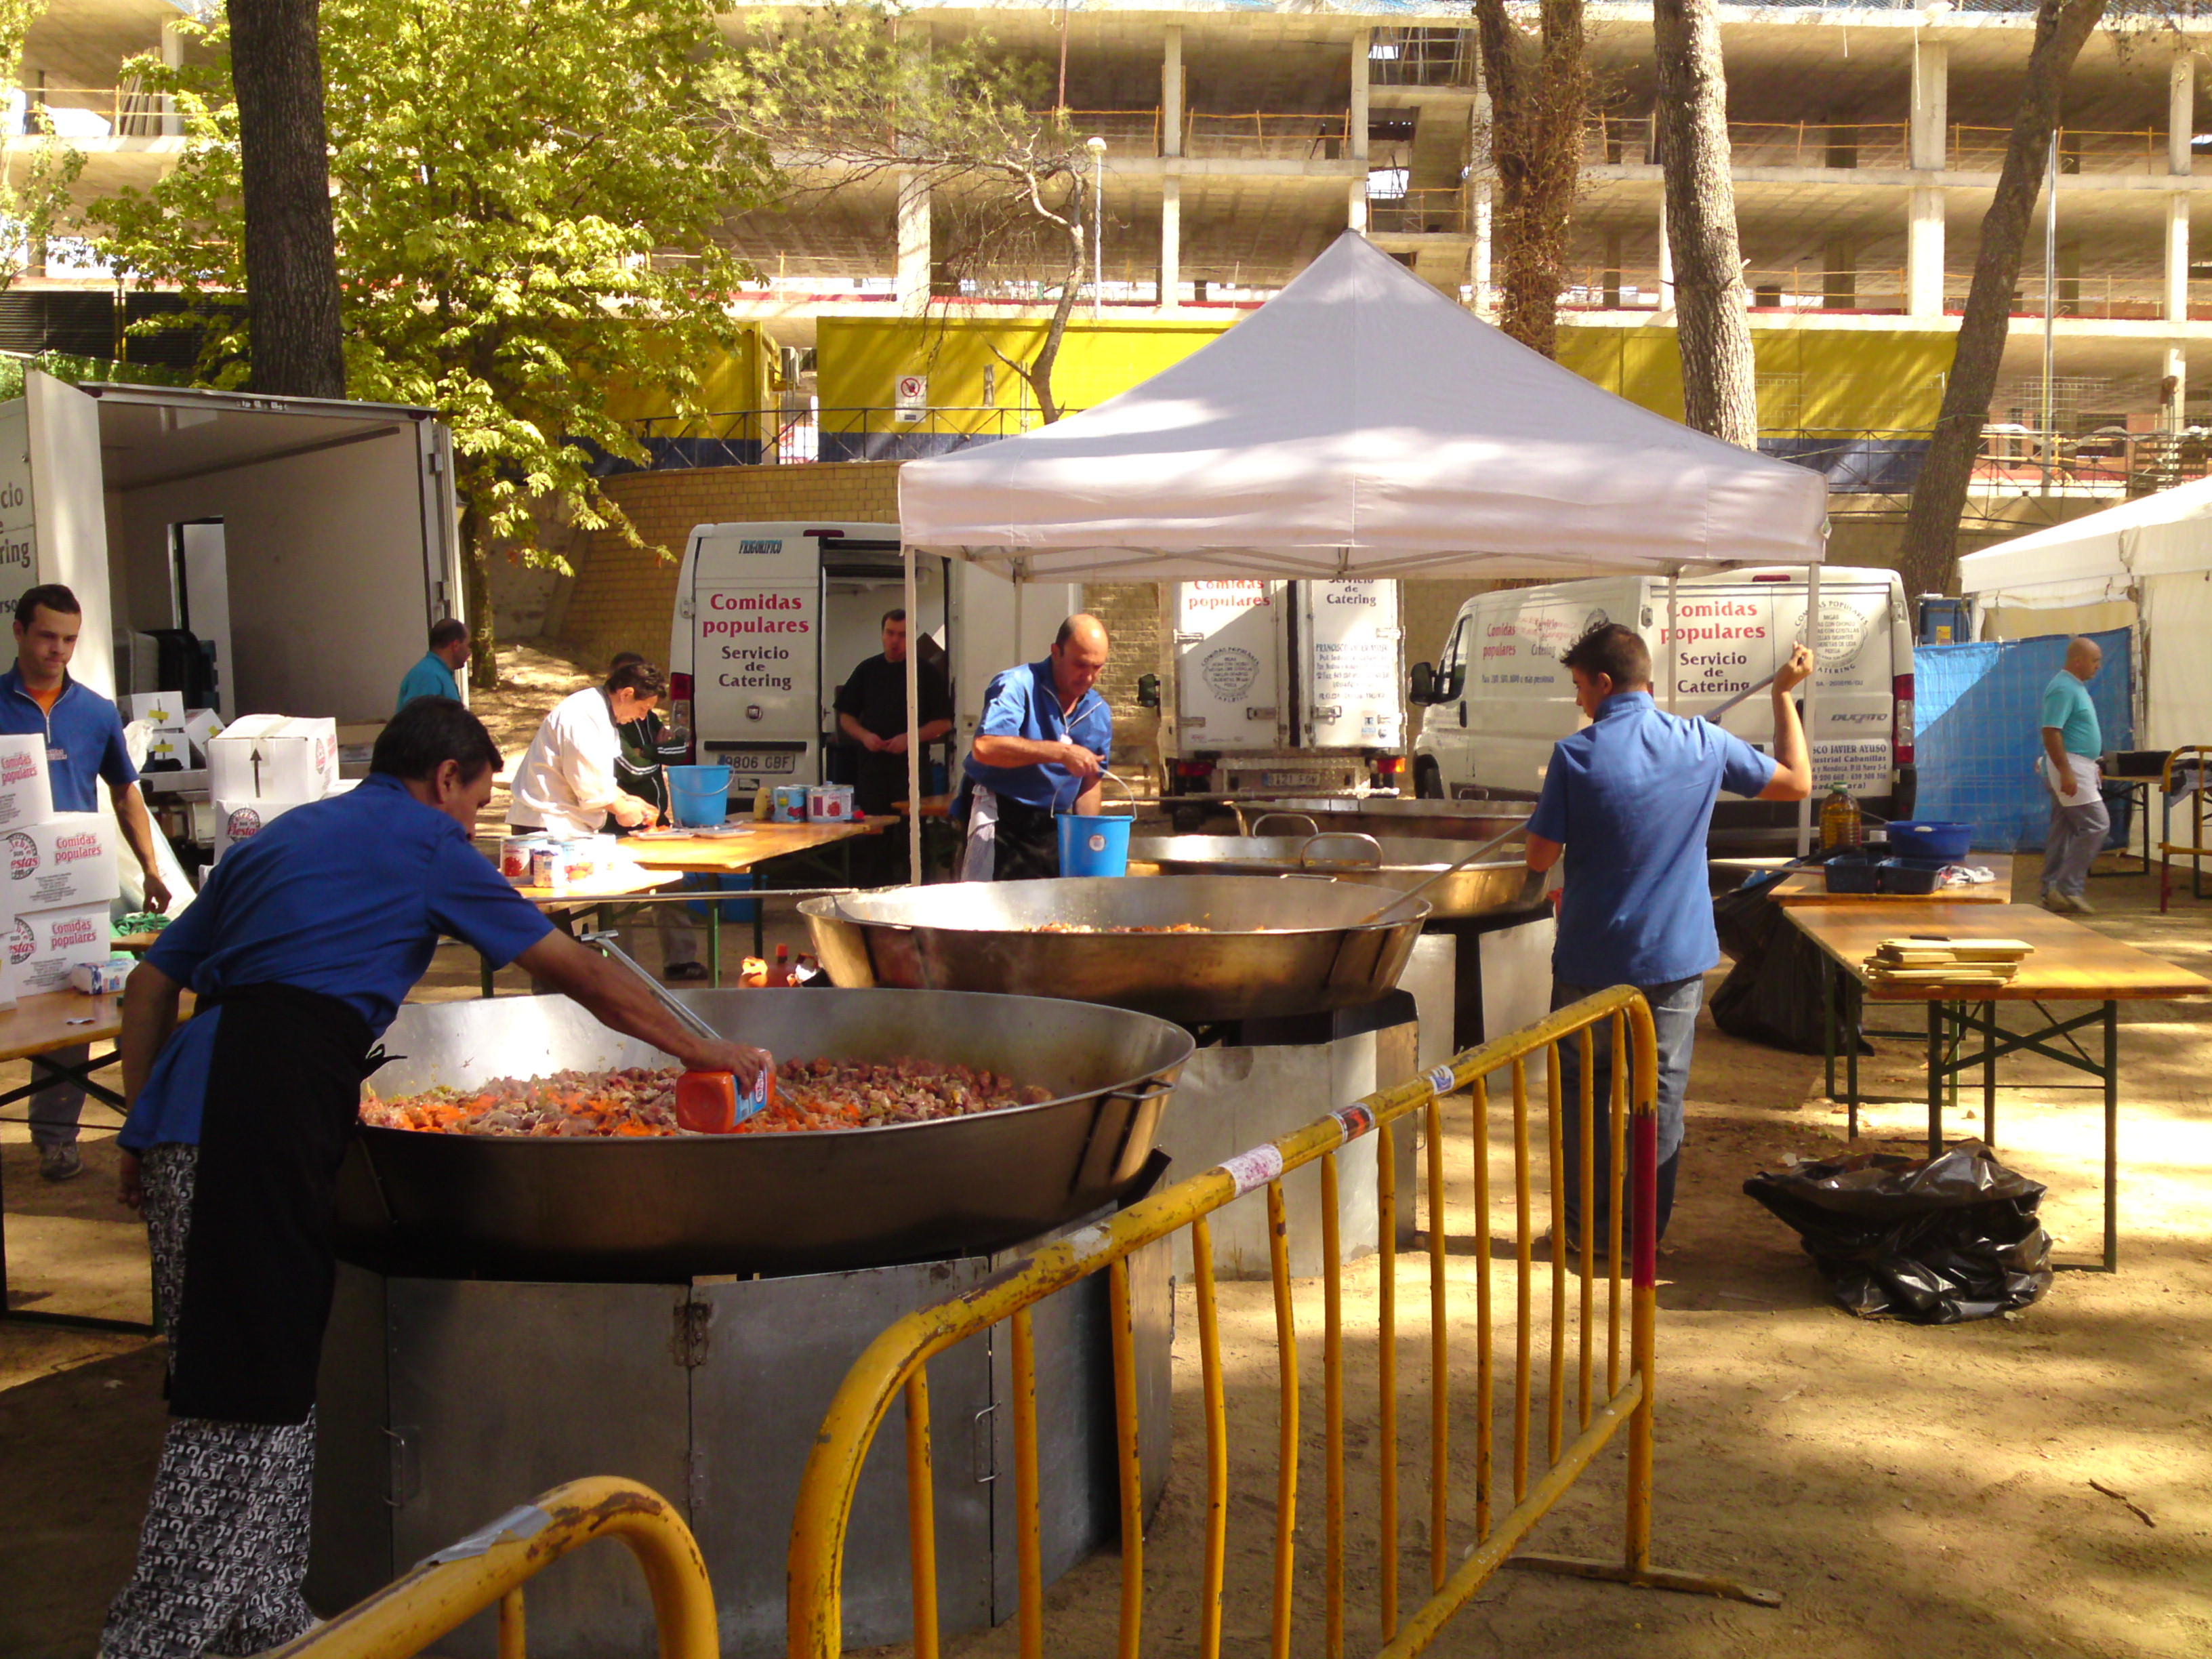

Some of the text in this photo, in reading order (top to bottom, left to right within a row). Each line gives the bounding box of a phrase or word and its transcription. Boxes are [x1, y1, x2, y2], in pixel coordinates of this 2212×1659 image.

[1345, 585, 1358, 593] de
[710, 594, 802, 610] Comidas
[1189, 595, 1271, 610] populares
[1326, 594, 1376, 607] Catering
[1828, 600, 1868, 626] POPULARES
[702, 617, 809, 638] populares
[1487, 622, 1516, 638] Comidas
[1660, 623, 1765, 644] populares
[721, 646, 789, 660] Servicio
[1483, 642, 1516, 660] populares
[1531, 644, 1556, 659] Catering
[1680, 652, 1747, 665] Servicio
[745, 661, 766, 672] de
[1704, 668, 1723, 677] de
[1818, 663, 1856, 674] ATERING
[718, 674, 792, 691] Catering
[1678, 680, 1750, 693] Catering
[1830, 745, 1857, 754] JAVIER
[1859, 744, 1887, 753] AYUSO
[1, 754, 33, 770] Comidas
[725, 756, 790, 769] 9806 GBF
[2, 766, 37, 785] populares
[227, 823, 259, 836] Fiesta
[56, 834, 96, 849] Comidas
[55, 845, 102, 864] populares
[11, 856, 39, 869] estas
[52, 918, 91, 935] Comidas
[51, 930, 97, 949] populares
[9, 941, 35, 954] stas
